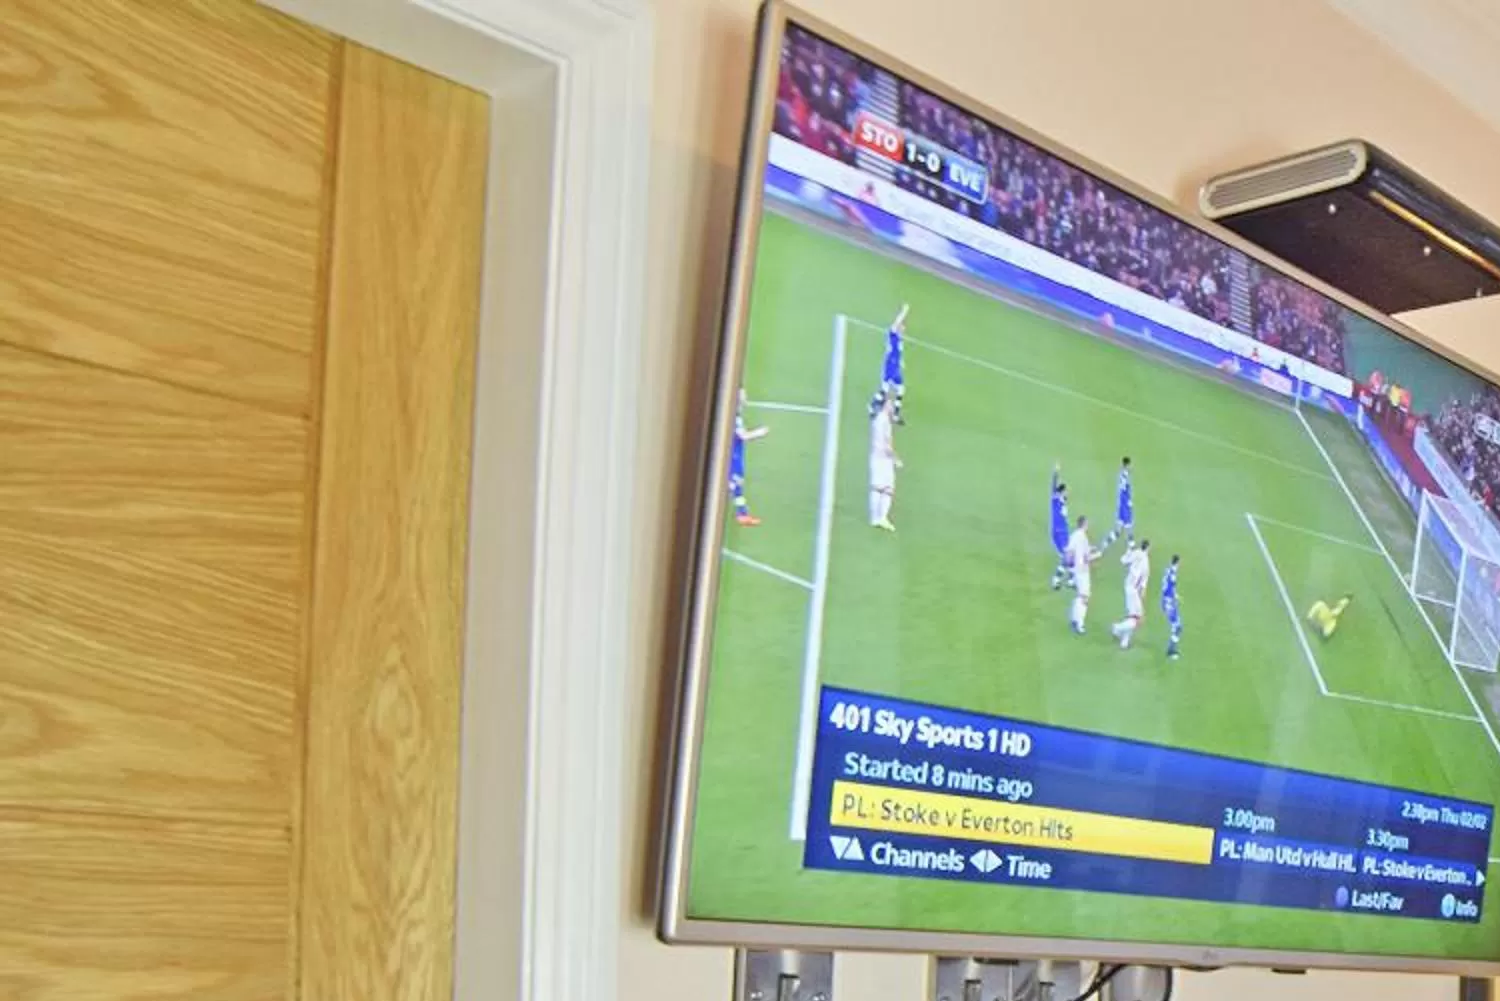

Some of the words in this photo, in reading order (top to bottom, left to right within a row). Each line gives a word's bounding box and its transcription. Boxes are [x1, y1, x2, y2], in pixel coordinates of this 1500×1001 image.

[860, 122, 898, 152] STO
[906, 143, 941, 173] 1-0
[950, 161, 984, 192] EVE
[830, 703, 869, 733] 401
[874, 710, 913, 745] Sky
[916, 718, 984, 750] Sports
[987, 728, 998, 752] 1
[1000, 732, 1031, 756] HD
[844, 752, 927, 783] Started
[931, 765, 944, 786] 8
[948, 767, 993, 793] mins
[997, 777, 1032, 801] ago
[843, 794, 874, 817] PL:
[881, 800, 939, 826] Stoke
[945, 812, 957, 827] v
[962, 808, 1033, 836] Everton
[870, 842, 964, 872] Channels
[1007, 854, 1051, 879] Time
[1243, 841, 1273, 863] Man
[1276, 844, 1302, 866] Utd
[1303, 852, 1311, 868] v
[1382, 858, 1415, 880] Stoke
